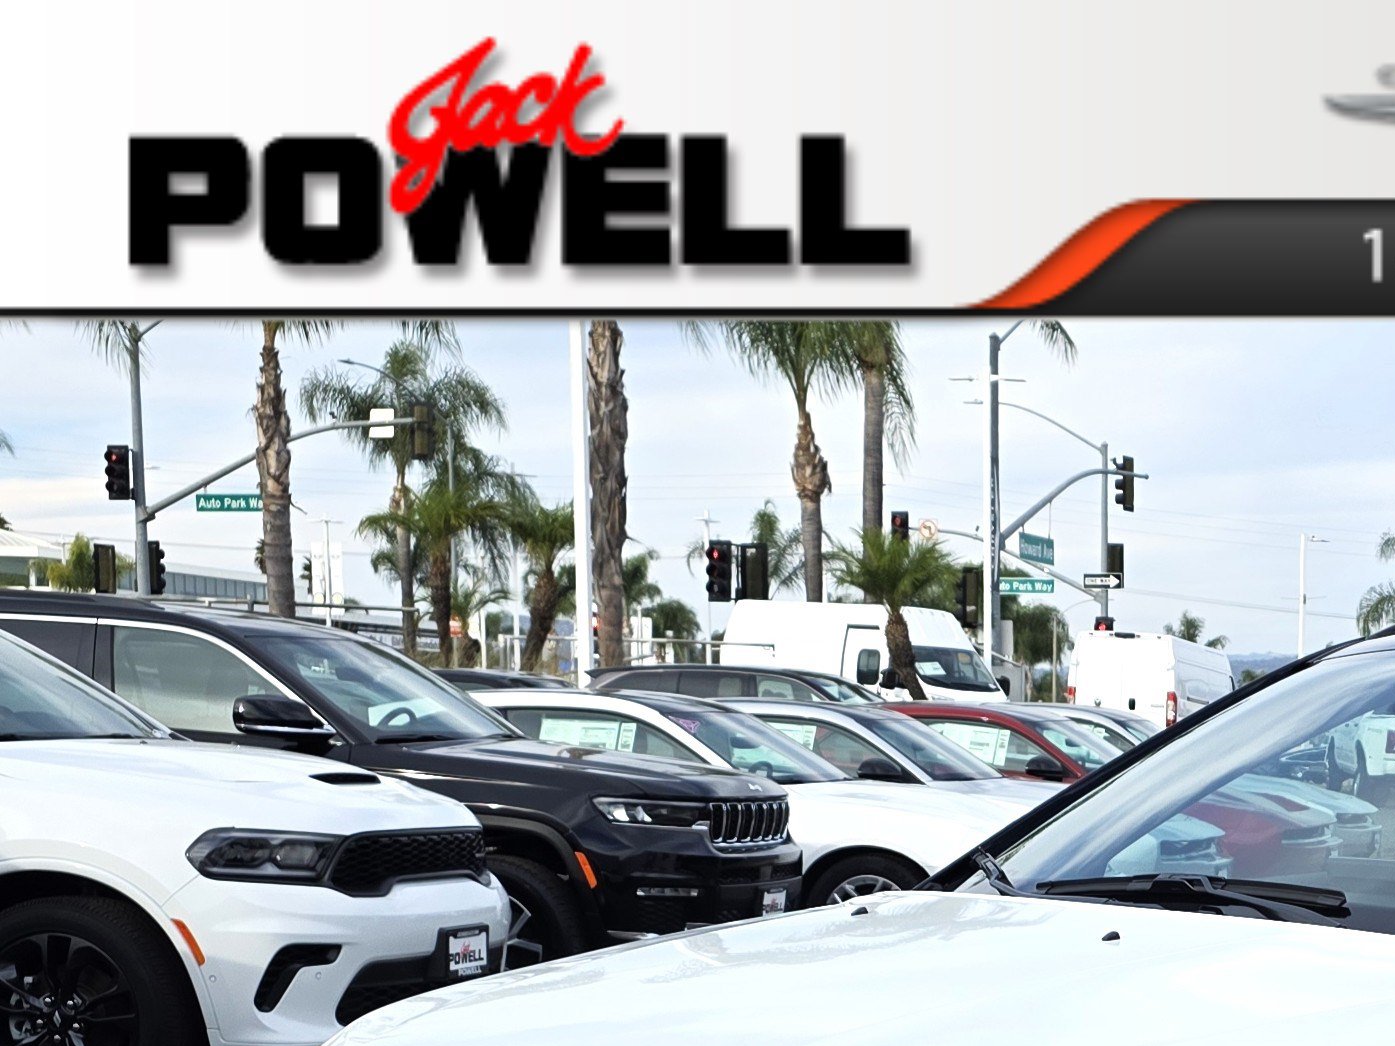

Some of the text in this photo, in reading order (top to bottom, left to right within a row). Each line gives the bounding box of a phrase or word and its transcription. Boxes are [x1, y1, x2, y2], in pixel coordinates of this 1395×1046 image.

[198, 497, 264, 509] Auto Park Wa
[1012, 581, 1033, 591] Park
[1034, 582, 1053, 593] Way
